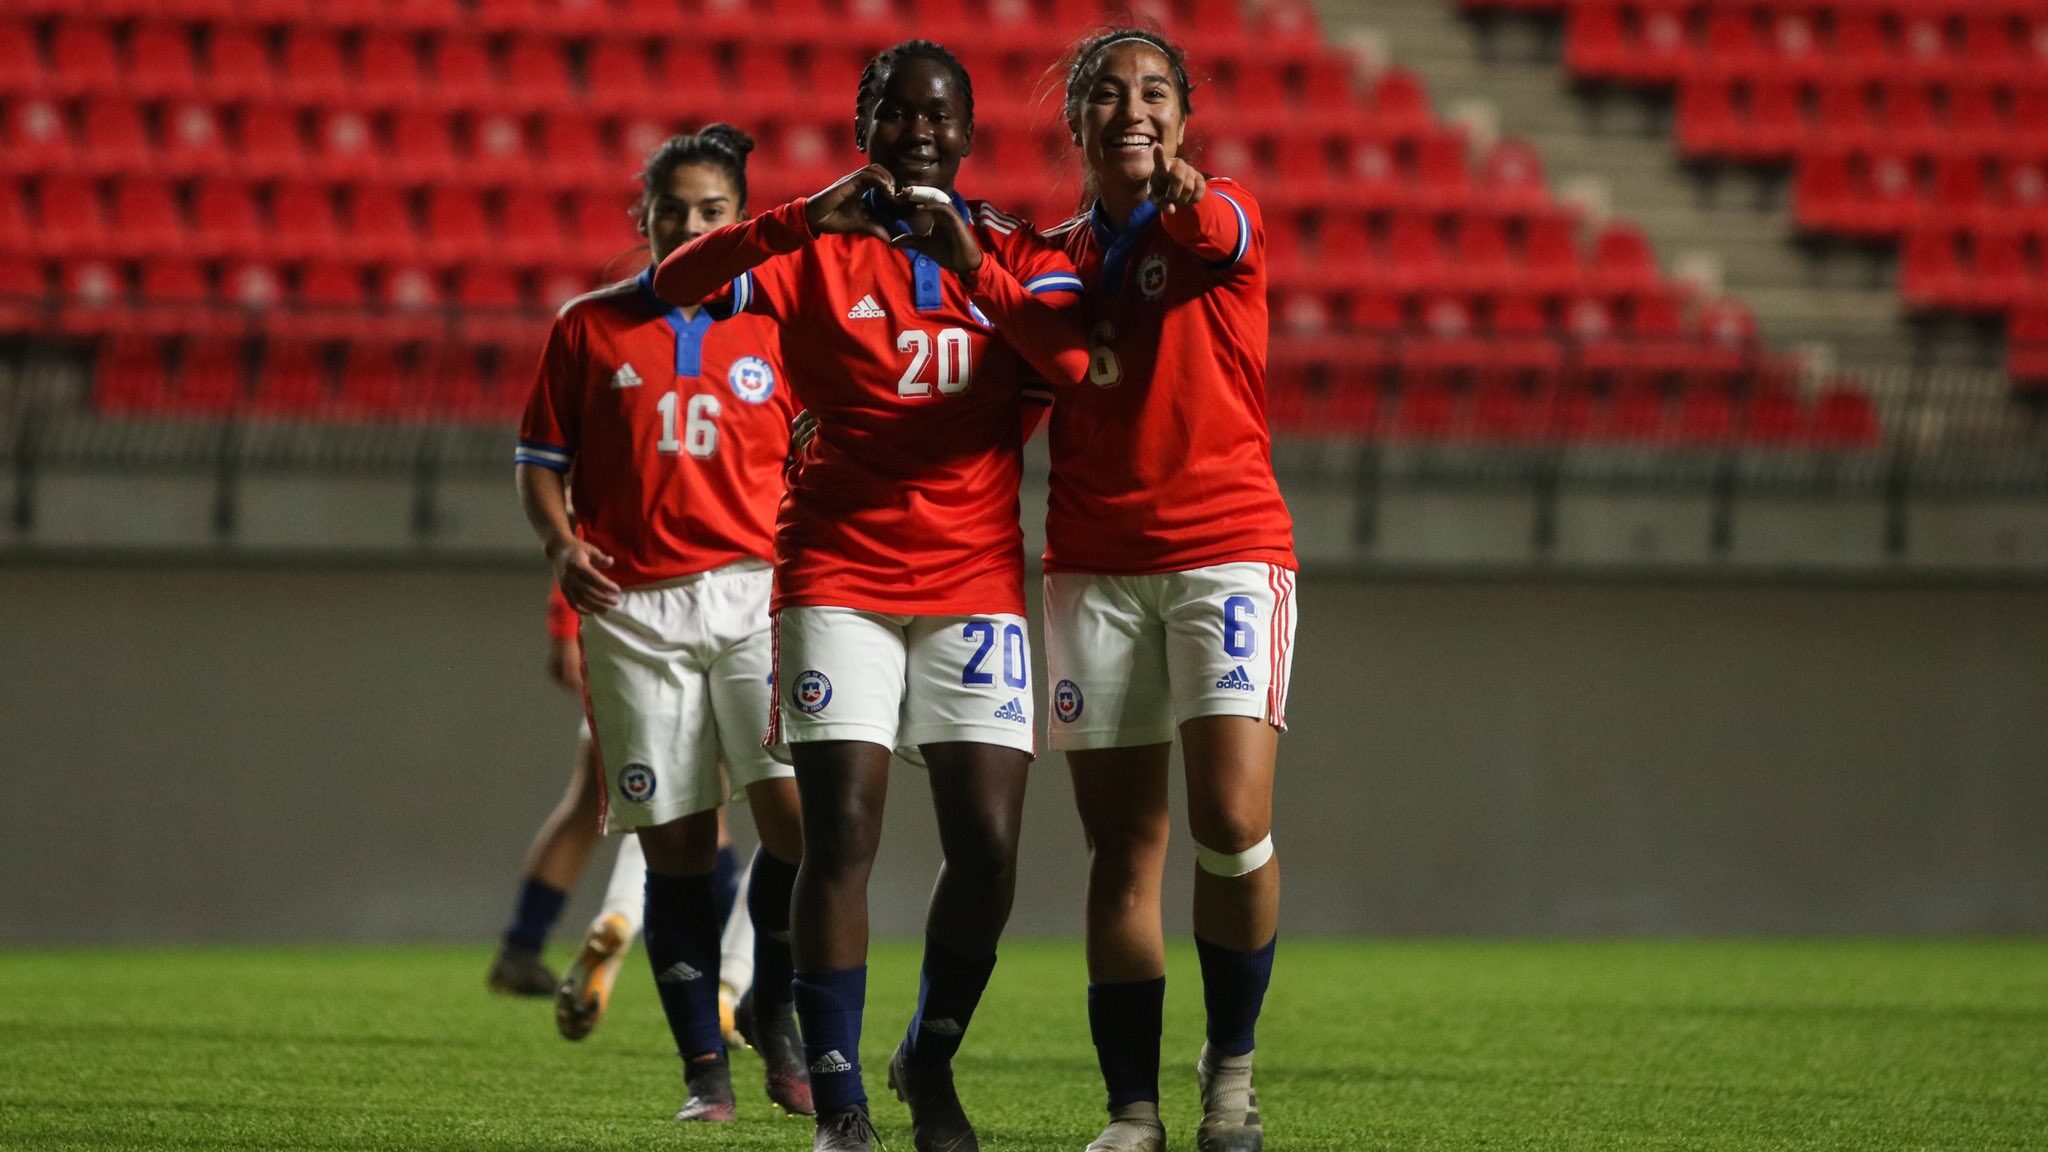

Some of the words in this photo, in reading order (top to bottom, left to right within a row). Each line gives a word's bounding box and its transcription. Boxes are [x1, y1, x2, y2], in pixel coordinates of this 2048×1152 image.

[848, 309, 886, 318] adidas
[897, 328, 972, 398] 20
[1089, 320, 1123, 388] 6
[657, 391, 722, 459] 16
[962, 622, 1027, 692] 20
[1224, 596, 1258, 661] 6
[994, 710, 1026, 724] adidas
[1216, 680, 1255, 691] adidas
[810, 1063, 851, 1072] adidas
